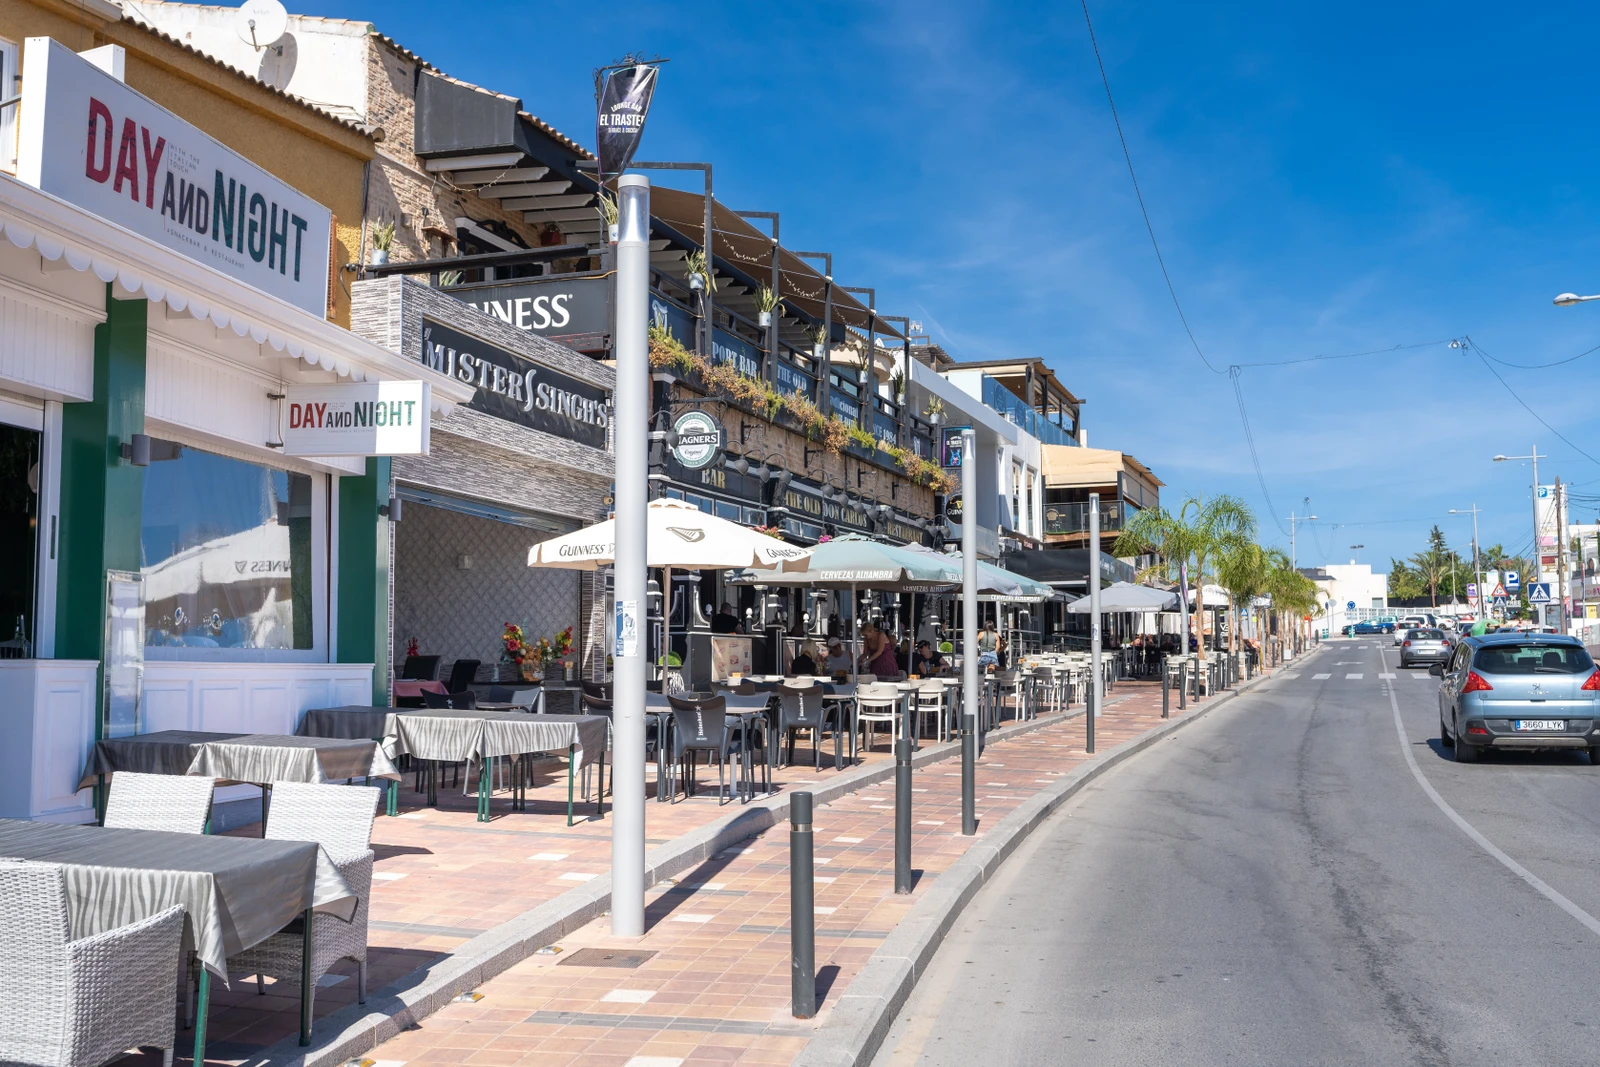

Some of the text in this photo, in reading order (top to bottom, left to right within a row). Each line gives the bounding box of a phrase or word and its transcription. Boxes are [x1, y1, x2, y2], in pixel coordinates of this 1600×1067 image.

[600, 114, 609, 126] EL
[85, 96, 308, 283] DAY AND NIGHT
[424, 340, 608, 428] MISTER SINGH'S
[792, 373, 807, 391] OLD
[289, 401, 416, 429] DAY AND NIGHT
[679, 434, 717, 445] AGNERS
[701, 468, 726, 489] BAR
[785, 490, 803, 510] THE
[803, 496, 821, 515] OLD
[823, 502, 840, 520] DON
[559, 544, 606, 557] GUINNESS
[820, 570, 893, 580] CERVEZAS ALHAMBRA
[1506, 572, 1518, 586] P
[1546, 721, 1563, 729] LYK
